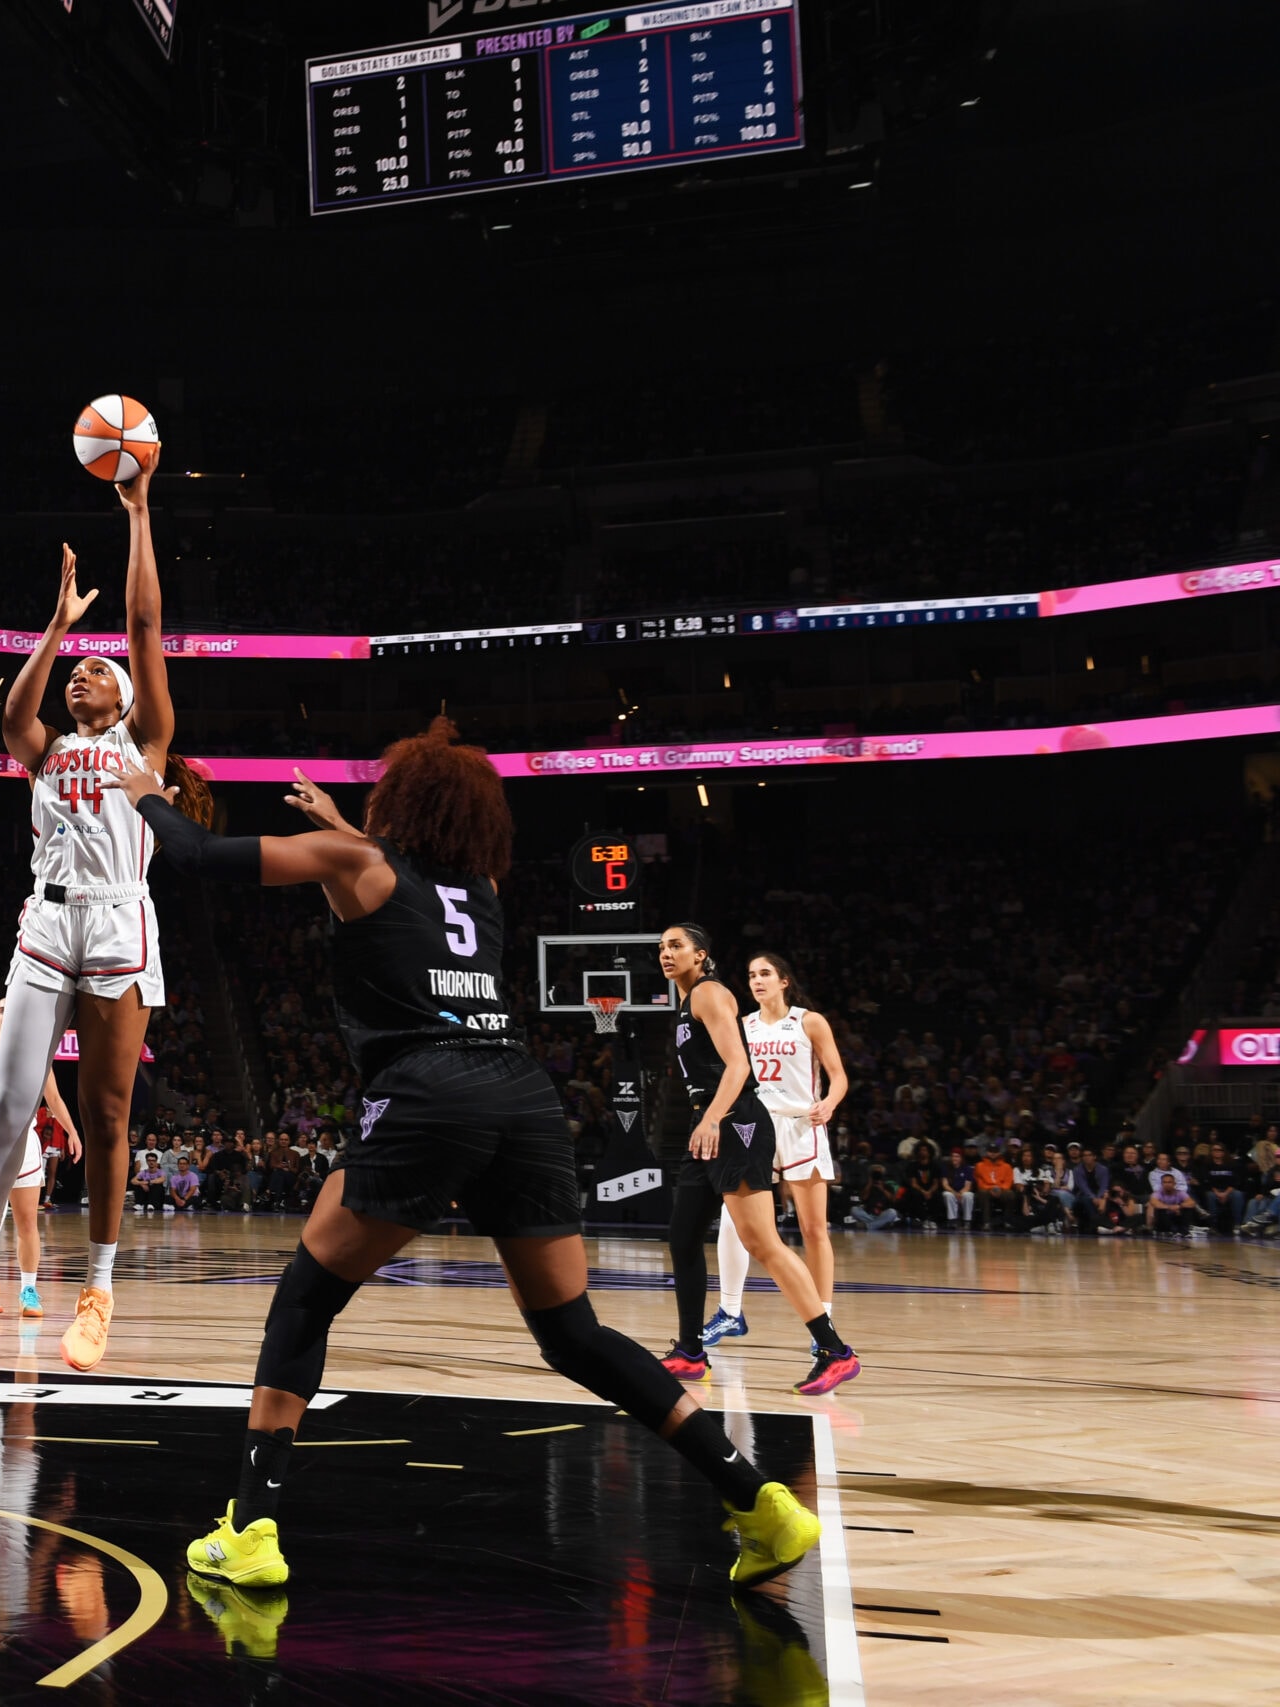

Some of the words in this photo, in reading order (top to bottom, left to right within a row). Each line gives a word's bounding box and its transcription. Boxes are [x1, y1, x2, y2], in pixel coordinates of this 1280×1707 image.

[714, 3, 741, 16] TEAM
[476, 28, 552, 56] PRESENTED
[556, 24, 575, 42] BY
[640, 37, 648, 52] 1
[321, 62, 358, 79] GOLDEN
[361, 57, 390, 73] STATE
[392, 52, 418, 69] TEAM
[421, 47, 451, 63] STATS
[511, 57, 521, 72] 0
[639, 58, 649, 73] 2
[763, 59, 774, 75] 2
[396, 76, 406, 90] 2
[446, 90, 461, 100] TO
[514, 78, 521, 92] 1
[639, 78, 650, 94] 2
[764, 80, 775, 95] 4
[399, 96, 406, 109] 1
[400, 116, 407, 129] 1
[514, 118, 523, 132] 2
[398, 135, 407, 149] 0
[495, 138, 524, 155] 40.0
[375, 155, 408, 172] 100.0
[504, 158, 525, 174] 0.0
[382, 175, 409, 192] 25.0
[751, 614, 763, 631] 8
[616, 624, 626, 639] 5
[11, 635, 74, 653] Guy
[78, 638, 179, 653] Supplnt
[377, 646, 384, 656] 2
[561, 634, 569, 644] 2
[530, 756, 596, 770] Choose
[600, 753, 634, 766] The
[638, 752, 659, 765] #1
[664, 750, 734, 764] Gummy
[739, 743, 855, 762] Supplement
[58, 778, 103, 814] 44
[591, 845, 628, 862] 6:38
[605, 862, 627, 890] 6
[594, 902, 636, 911] TISSOT
[435, 884, 478, 957] 5
[428, 969, 497, 1000] THORNTON
[466, 1013, 510, 1031] AT&T
[756, 1059, 782, 1082] 22
[603, 1173, 655, 1197] IREN
